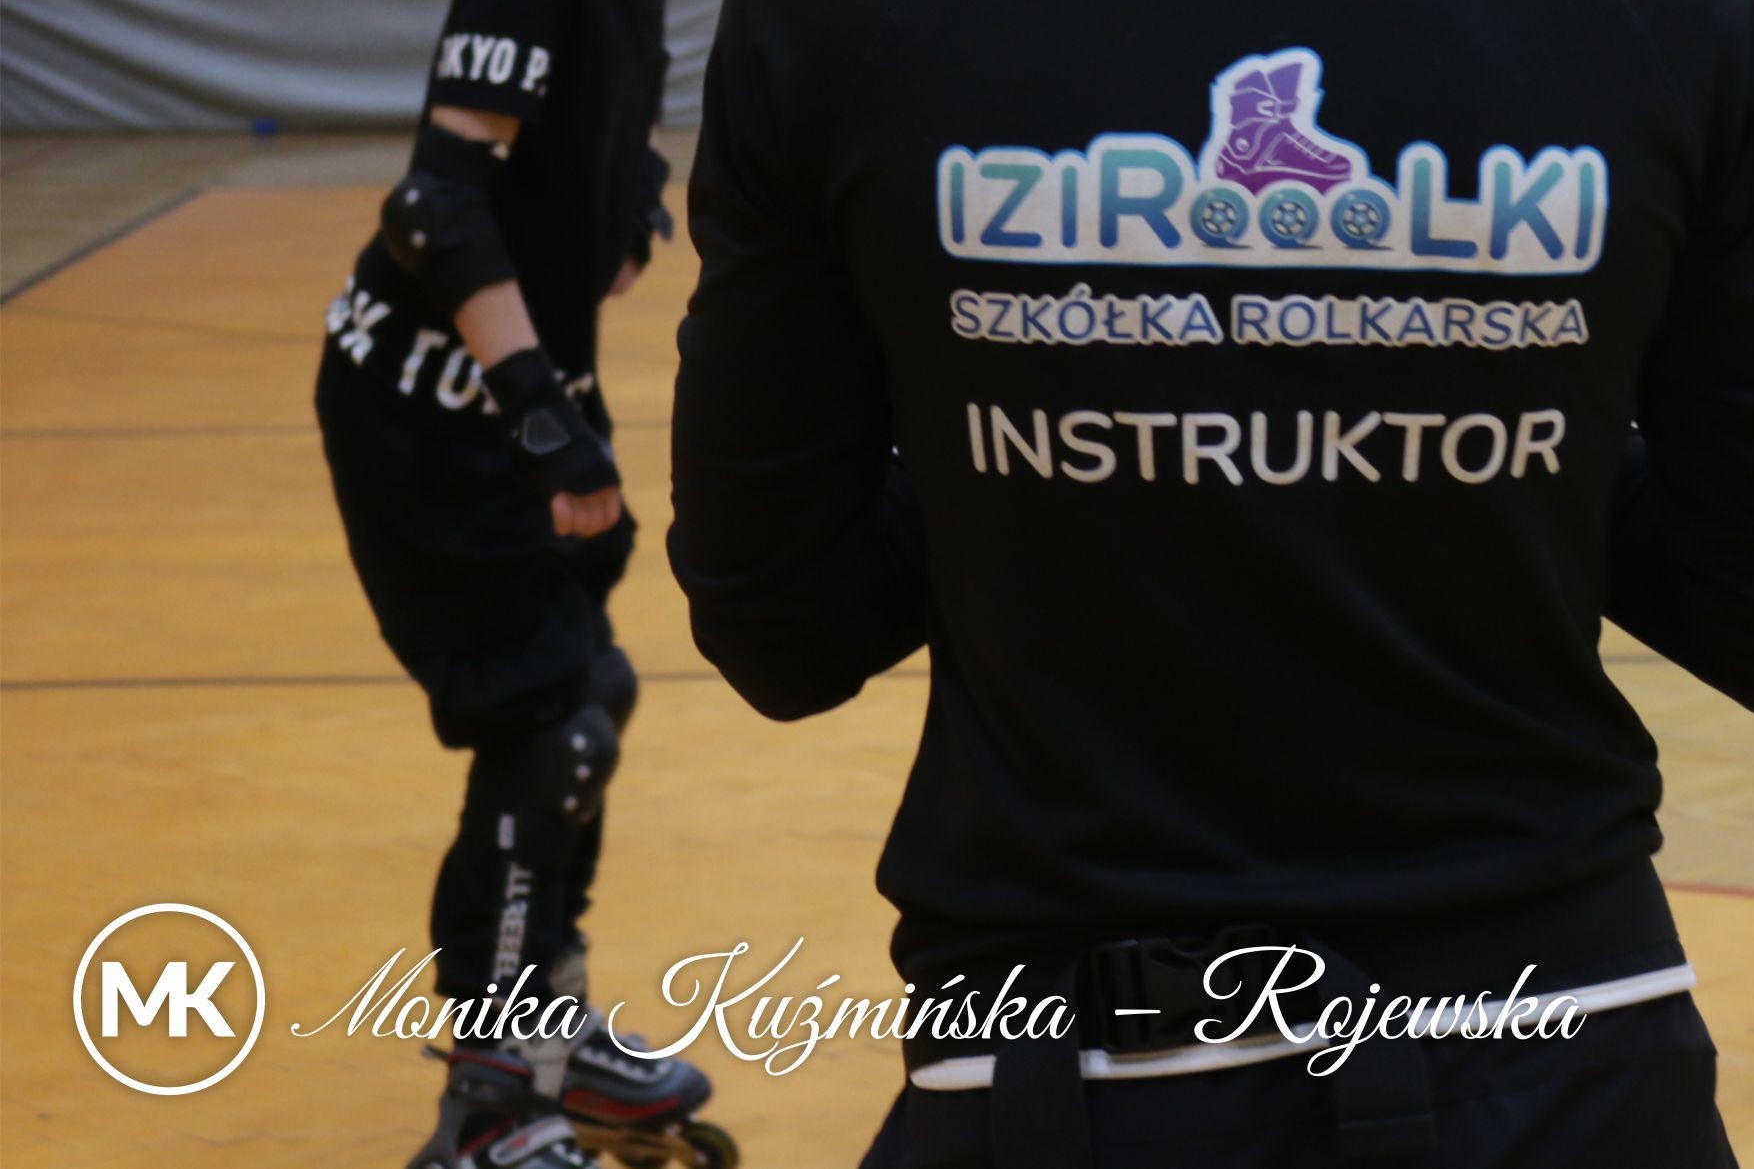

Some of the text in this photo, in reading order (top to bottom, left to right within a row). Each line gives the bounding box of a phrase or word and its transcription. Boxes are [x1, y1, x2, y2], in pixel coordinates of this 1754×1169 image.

[438, 33, 518, 86] KYO
[953, 286, 1588, 347] SZKÓŁKA ROLKARSKA
[967, 403, 1565, 486] INSTRUKTOR
